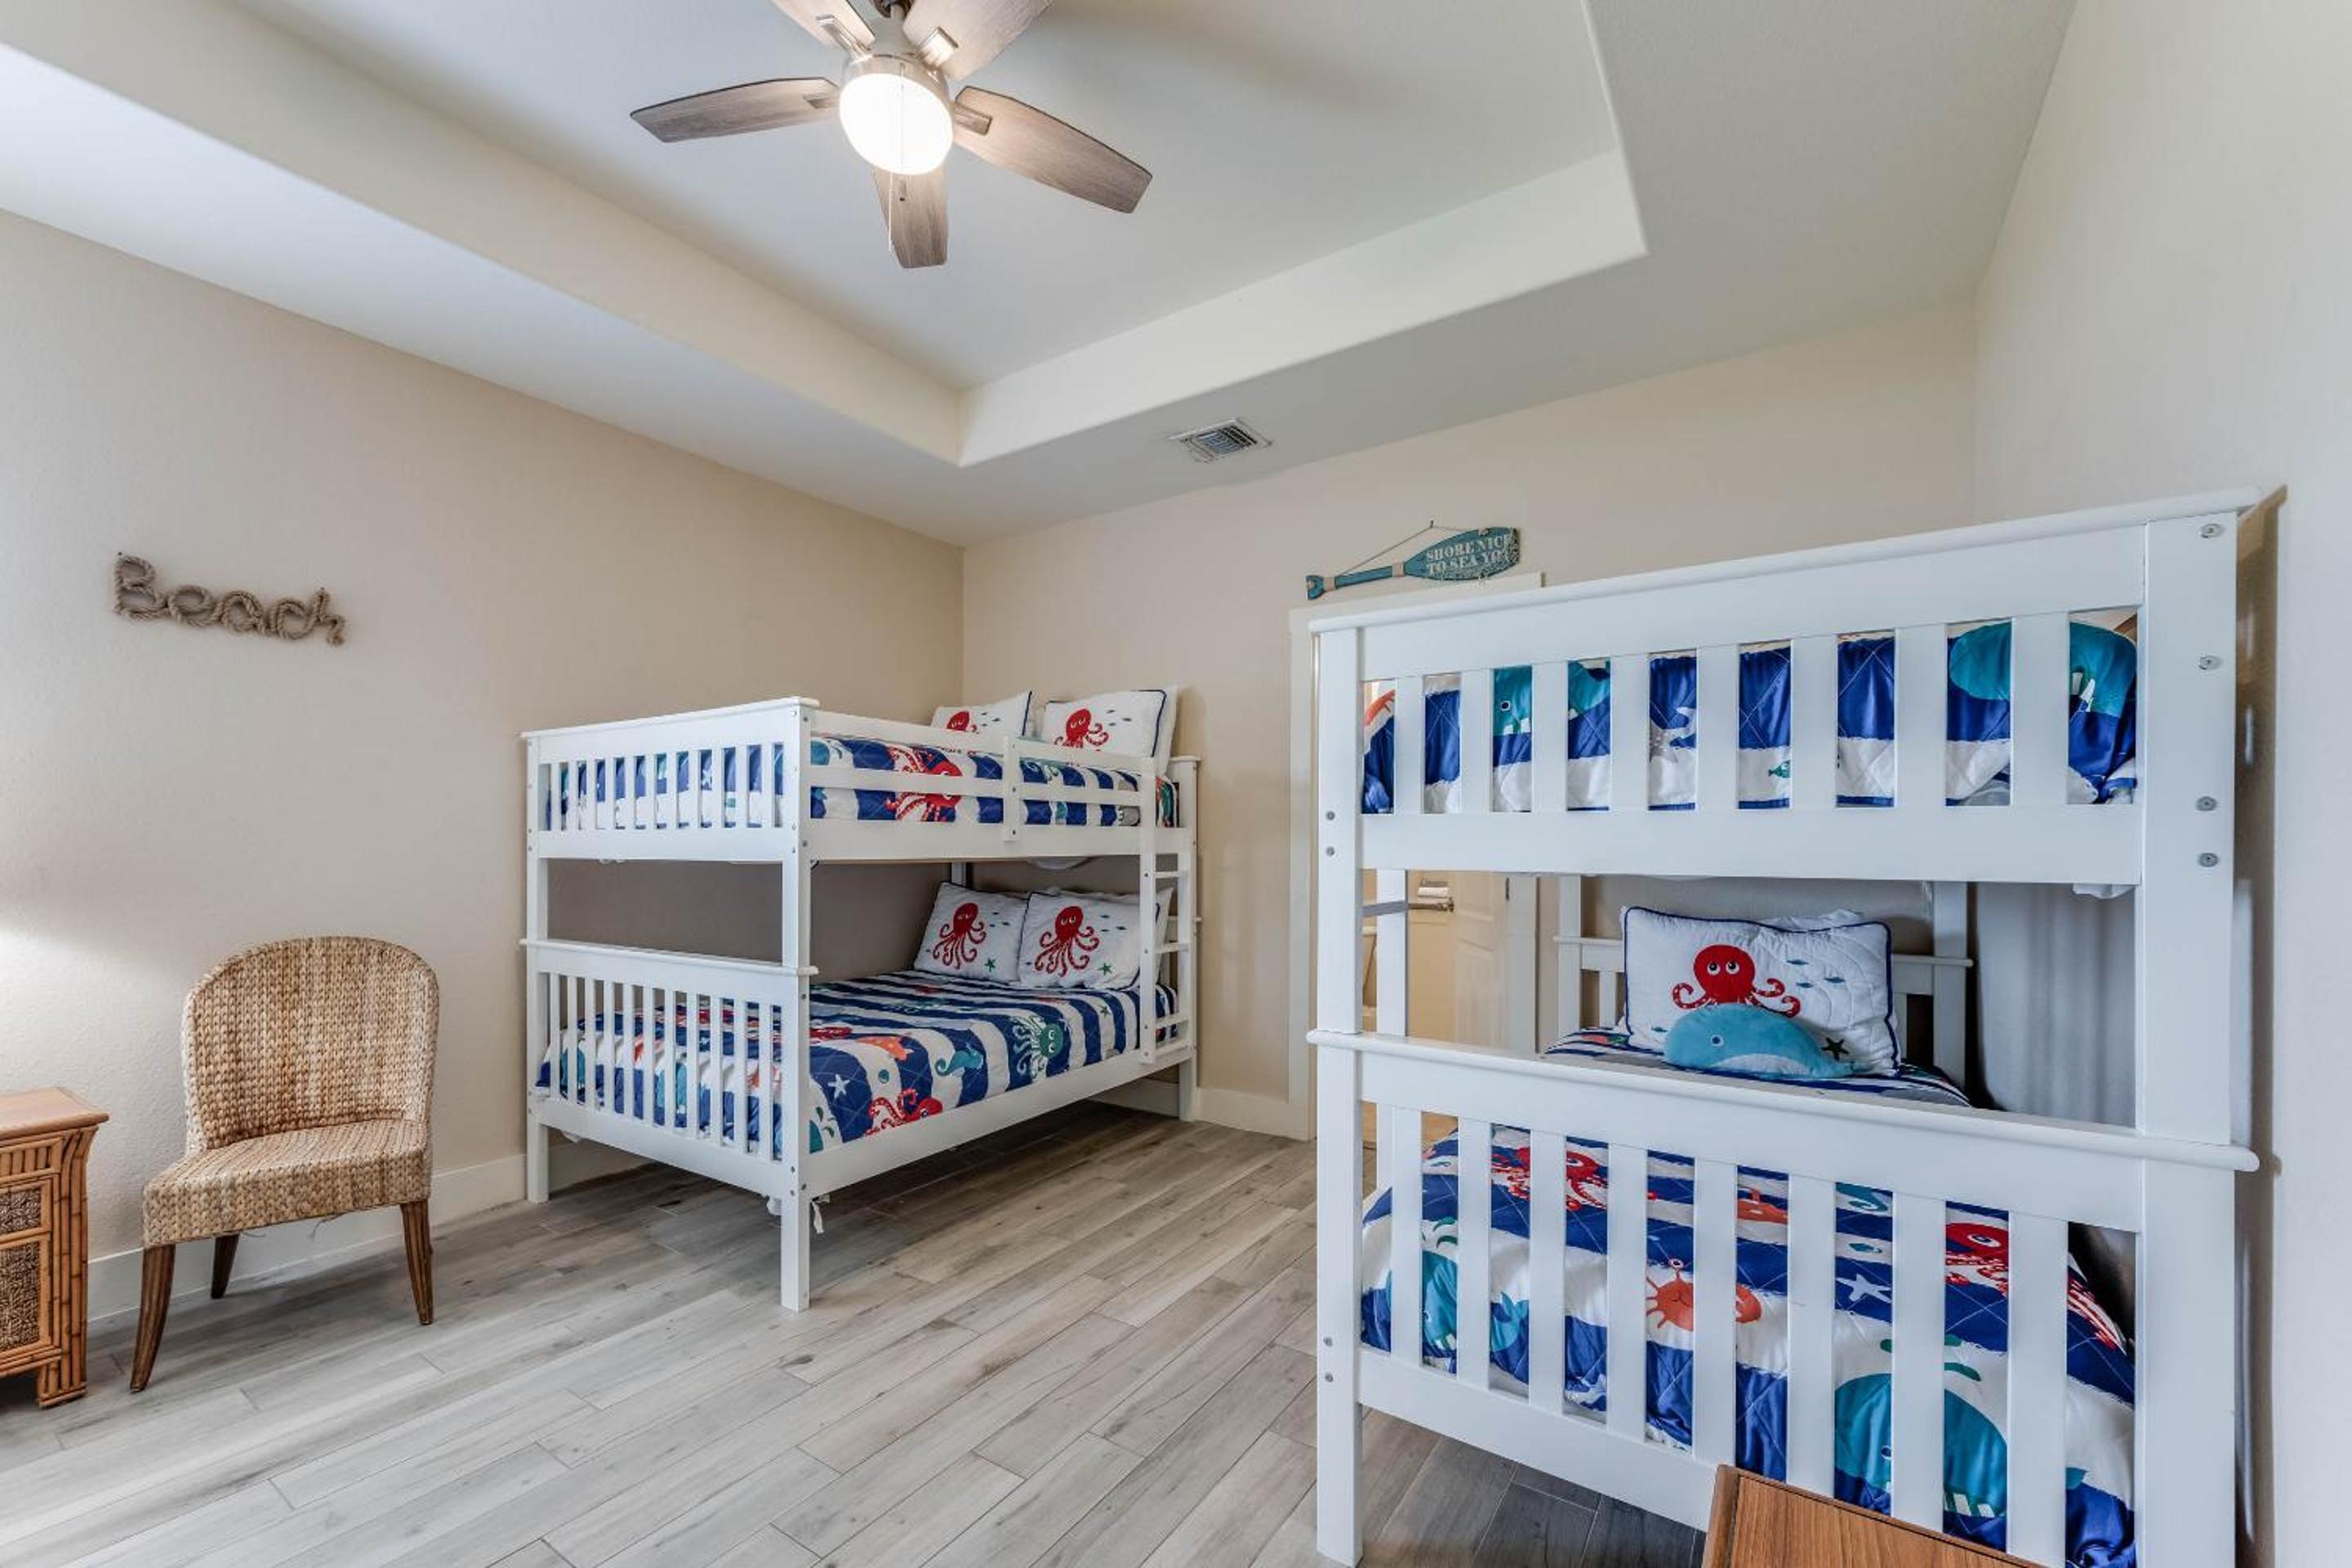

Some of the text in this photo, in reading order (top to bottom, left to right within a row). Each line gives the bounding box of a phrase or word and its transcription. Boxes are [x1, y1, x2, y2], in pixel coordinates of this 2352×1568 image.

[1426, 541, 1475, 563] SHORE
[1426, 561, 1446, 575] TO
[1450, 555, 1478, 568] SEA
[114, 555, 345, 645] Beach
